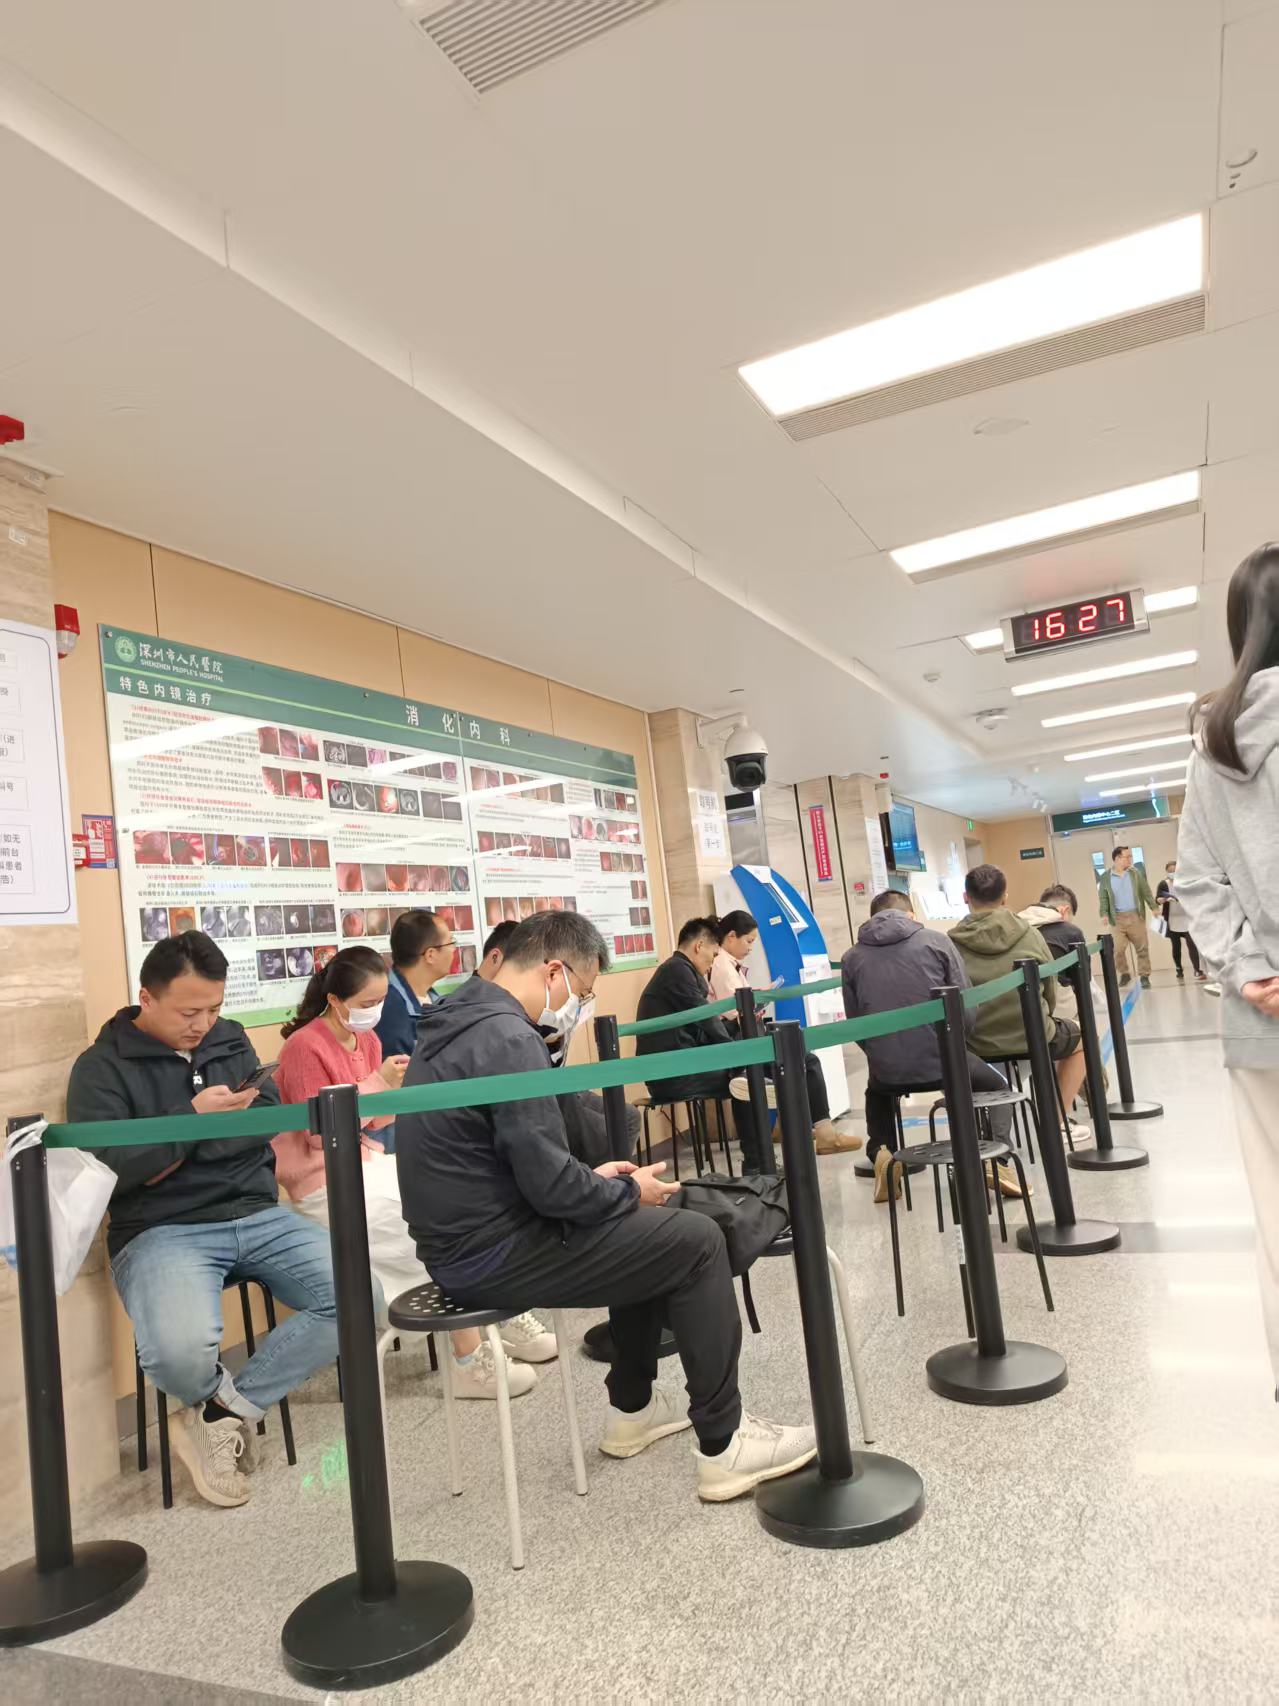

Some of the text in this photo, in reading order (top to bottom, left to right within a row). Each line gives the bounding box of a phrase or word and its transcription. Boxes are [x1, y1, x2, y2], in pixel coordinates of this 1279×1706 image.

[140, 659, 224, 682] SHENZHEN PEOPLE'S HOSPITAL
[119, 676, 213, 706] 特色内镜治疗
[405, 704, 511, 746] 消化内科
[0, 847, 19, 858] 前台
